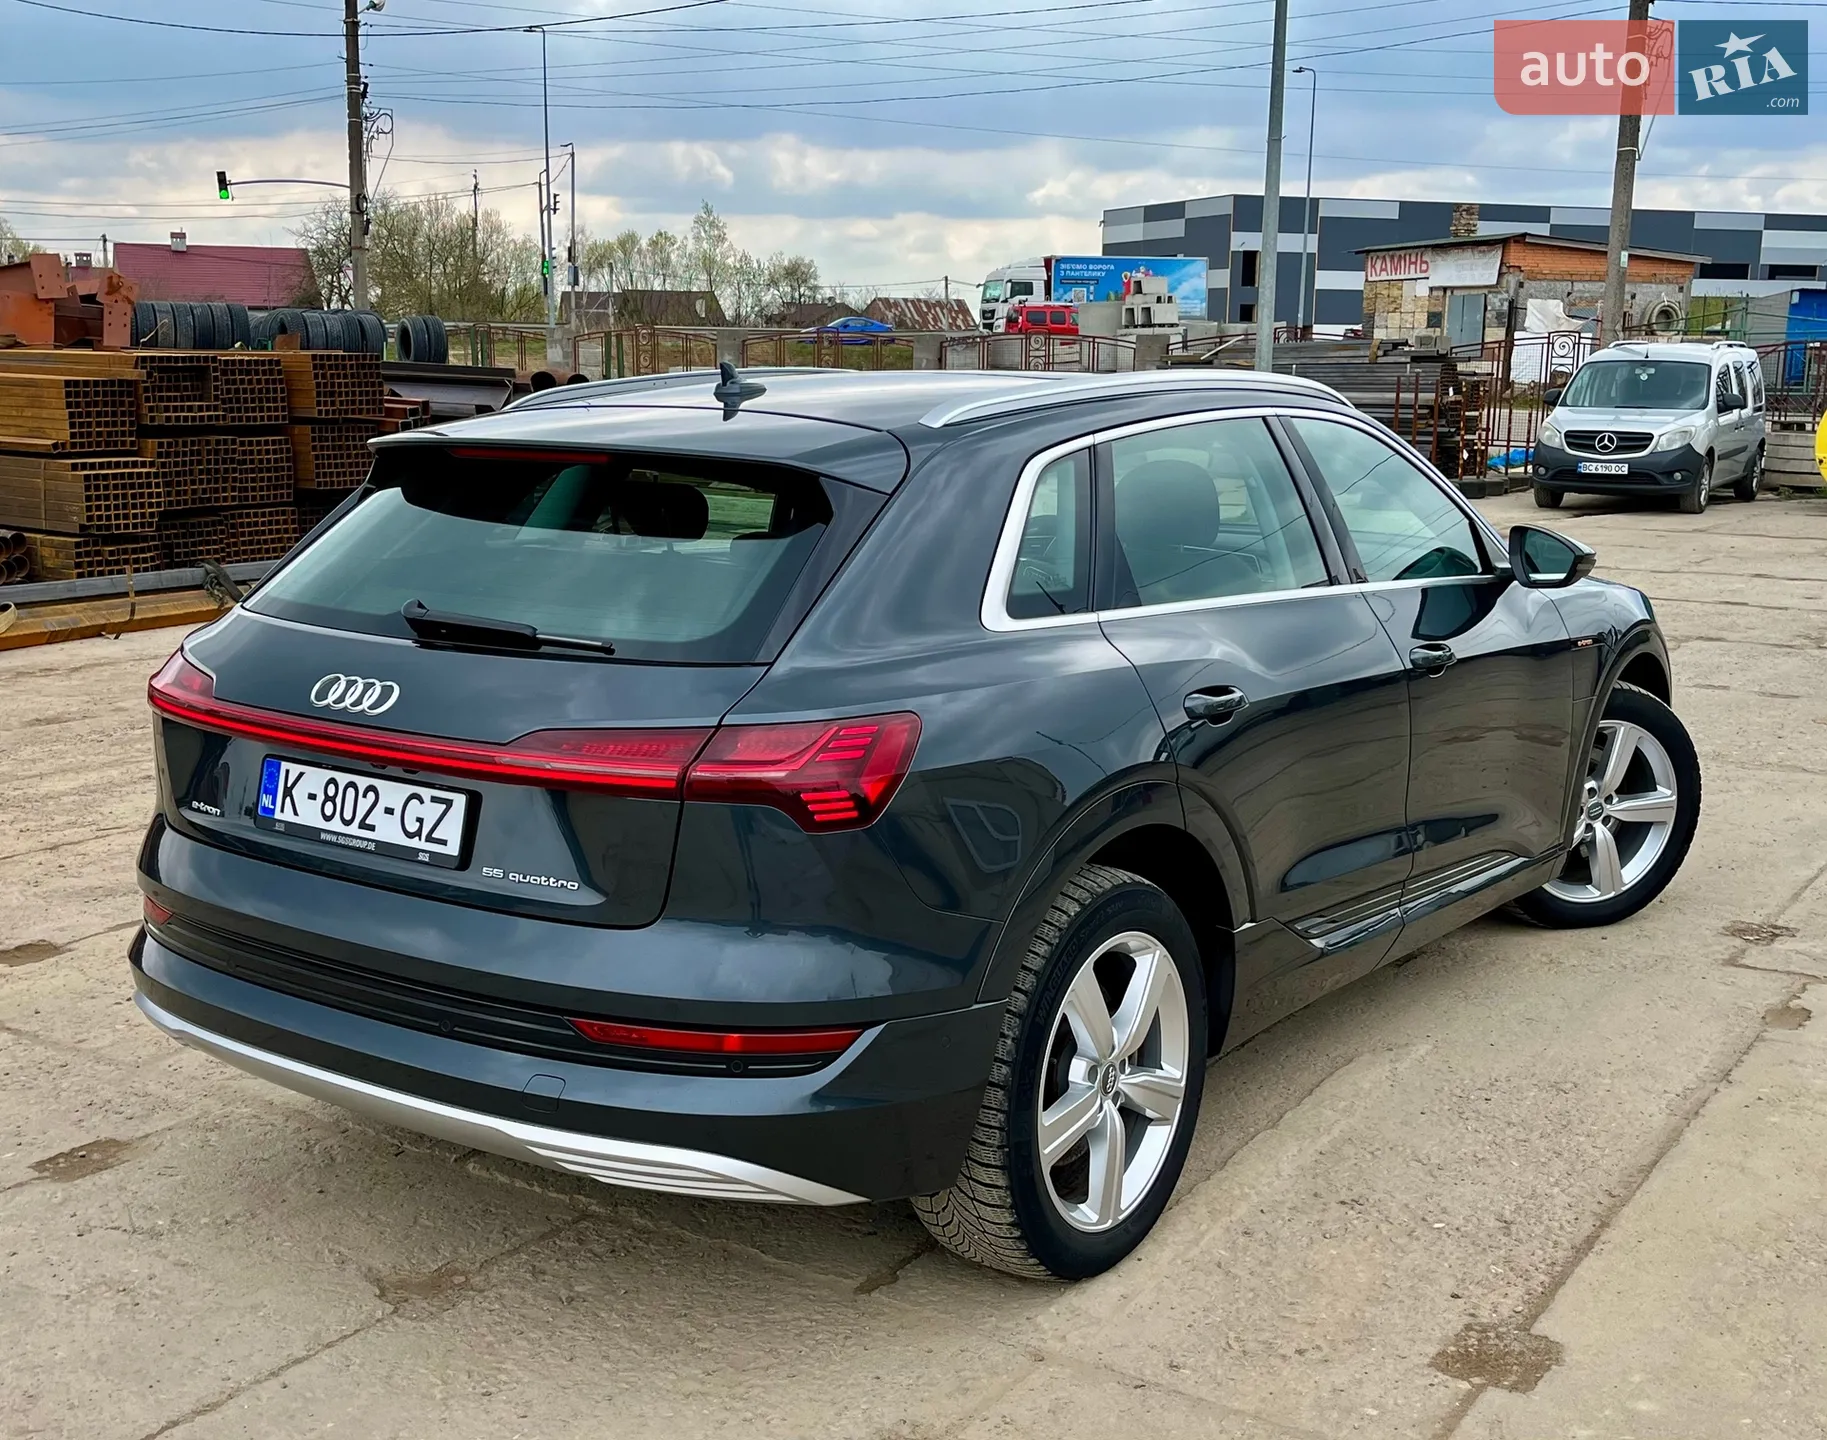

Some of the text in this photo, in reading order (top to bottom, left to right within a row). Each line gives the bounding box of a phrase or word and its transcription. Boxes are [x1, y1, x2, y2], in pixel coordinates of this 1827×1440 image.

[1370, 252, 1429, 277] КАМІНЬ
[1595, 464, 1613, 472] 6190
[191, 800, 221, 816] e-tron
[261, 793, 275, 809] NL
[280, 768, 454, 846] K-802-GZ
[320, 832, 376, 851] WWW.SGSGROUP.DE
[482, 866, 579, 890] 55 quattro
[1037, 939, 1079, 1026] WINGUARD
